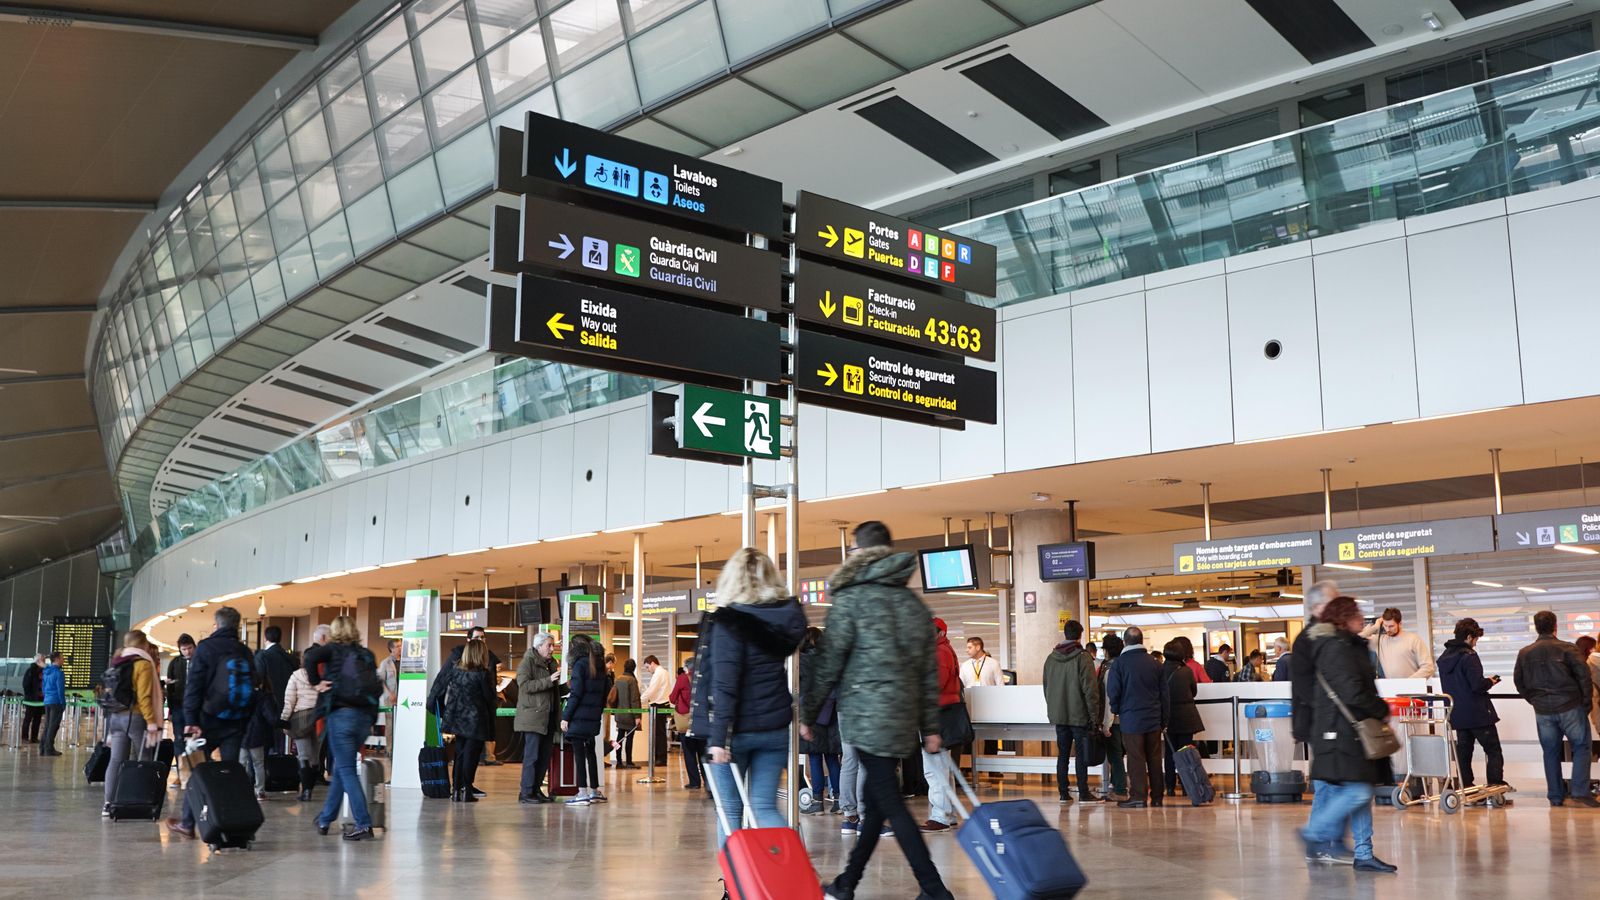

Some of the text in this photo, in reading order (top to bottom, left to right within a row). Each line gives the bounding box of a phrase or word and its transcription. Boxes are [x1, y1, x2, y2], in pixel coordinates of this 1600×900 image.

[673, 164, 717, 187] Lavabos
[674, 179, 700, 196] Toilets
[673, 194, 705, 212] Aseos
[869, 221, 899, 240] Portes
[650, 236, 717, 264] Guàrdia Civil
[868, 236, 890, 250] Gates
[911, 233, 969, 261] A B C R
[650, 252, 699, 273] Guardia Civil
[868, 248, 904, 268] Puertas
[910, 256, 952, 278] D E F
[650, 267, 717, 293] Guardia Civil
[580, 299, 617, 319] Eixida
[868, 288, 916, 311] Facturació
[868, 302, 898, 319] Check-in
[581, 315, 617, 333] Way out
[867, 315, 921, 339] Facturación
[580, 330, 617, 350] Salida
[924, 317, 981, 352] 43 to a 63
[868, 356, 955, 385] Control de seguretat
[869, 370, 921, 390] Security control
[868, 383, 957, 411] Control de seguridad
[1357, 527, 1433, 542] Control de seguretat
[1357, 539, 1403, 550] Security Control
[1219, 544, 1233, 553] amb
[1233, 543, 1259, 553] targeta
[1259, 538, 1313, 550] d'embarcament
[1358, 544, 1435, 559] Control de seguridad
[1211, 561, 1224, 570] con
[1247, 558, 1257, 567] de
[1256, 556, 1291, 567] embarque
